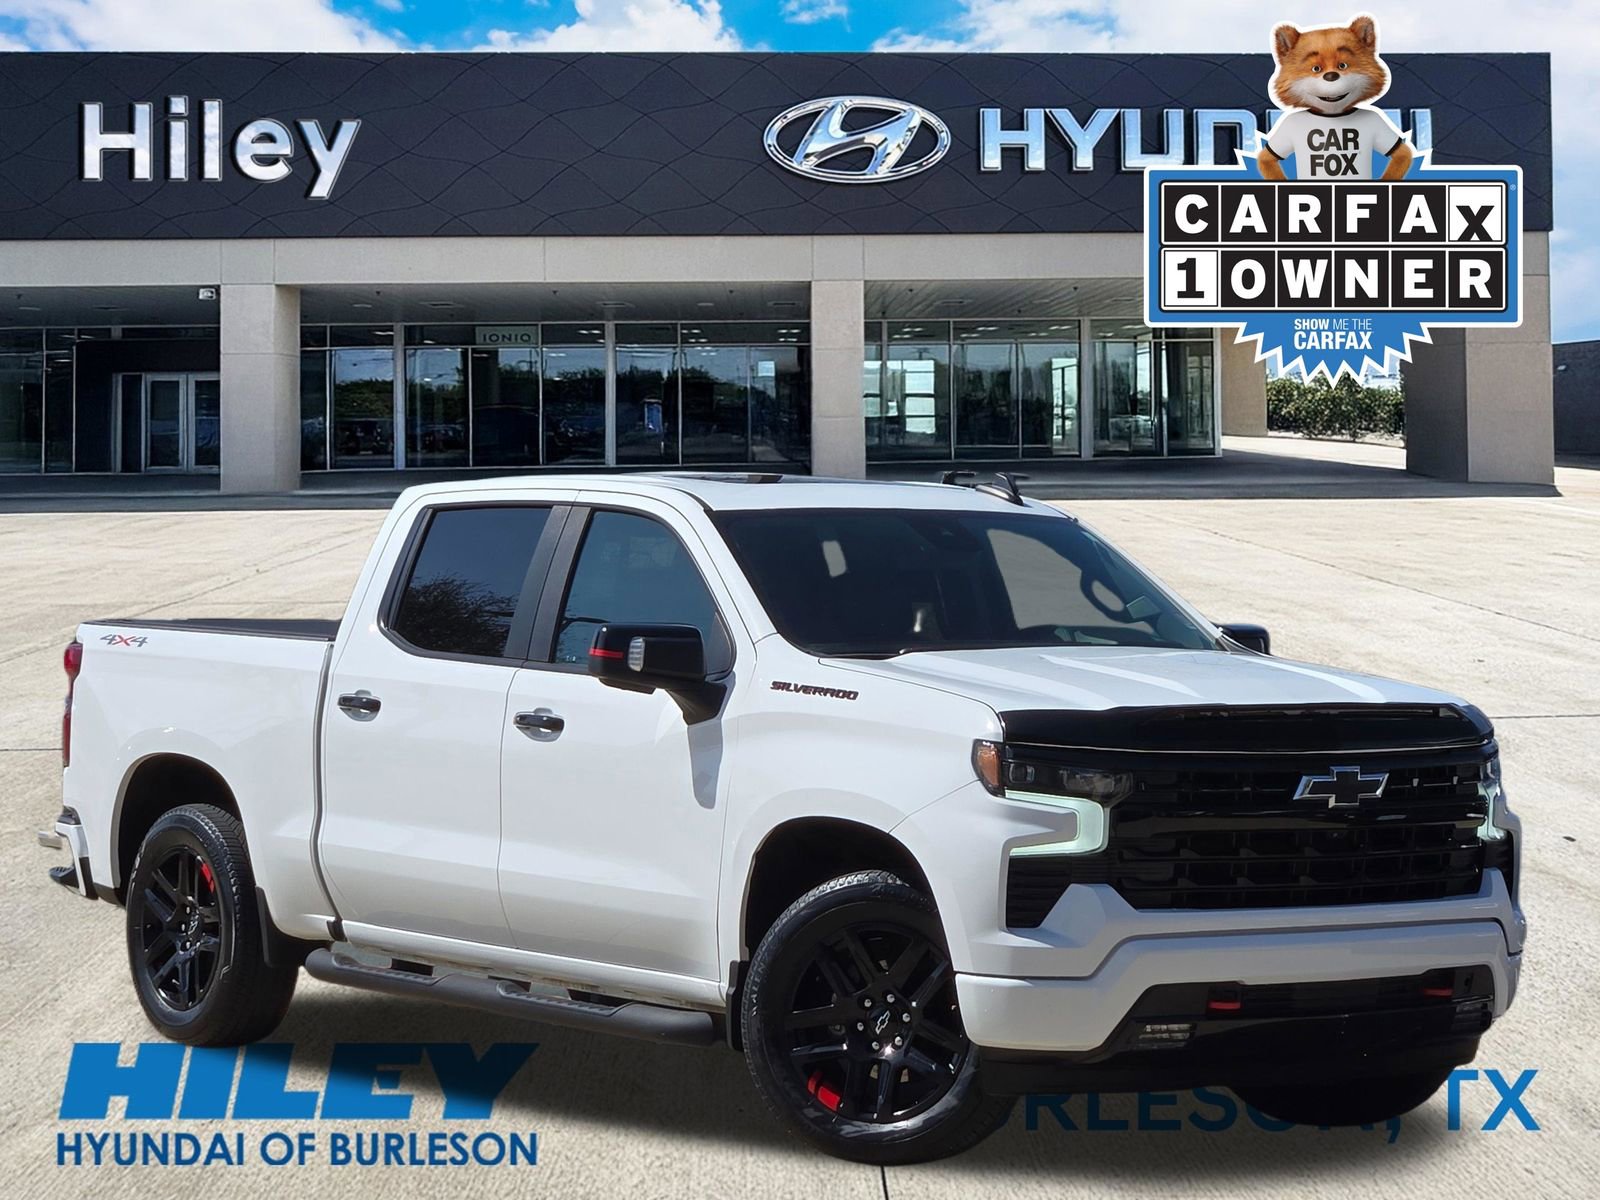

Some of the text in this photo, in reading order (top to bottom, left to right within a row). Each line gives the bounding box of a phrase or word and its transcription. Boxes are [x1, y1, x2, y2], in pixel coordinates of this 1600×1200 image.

[79, 94, 362, 200] Hiley
[979, 107, 1433, 171] HYUNI
[769, 680, 860, 701] SILVERADO
